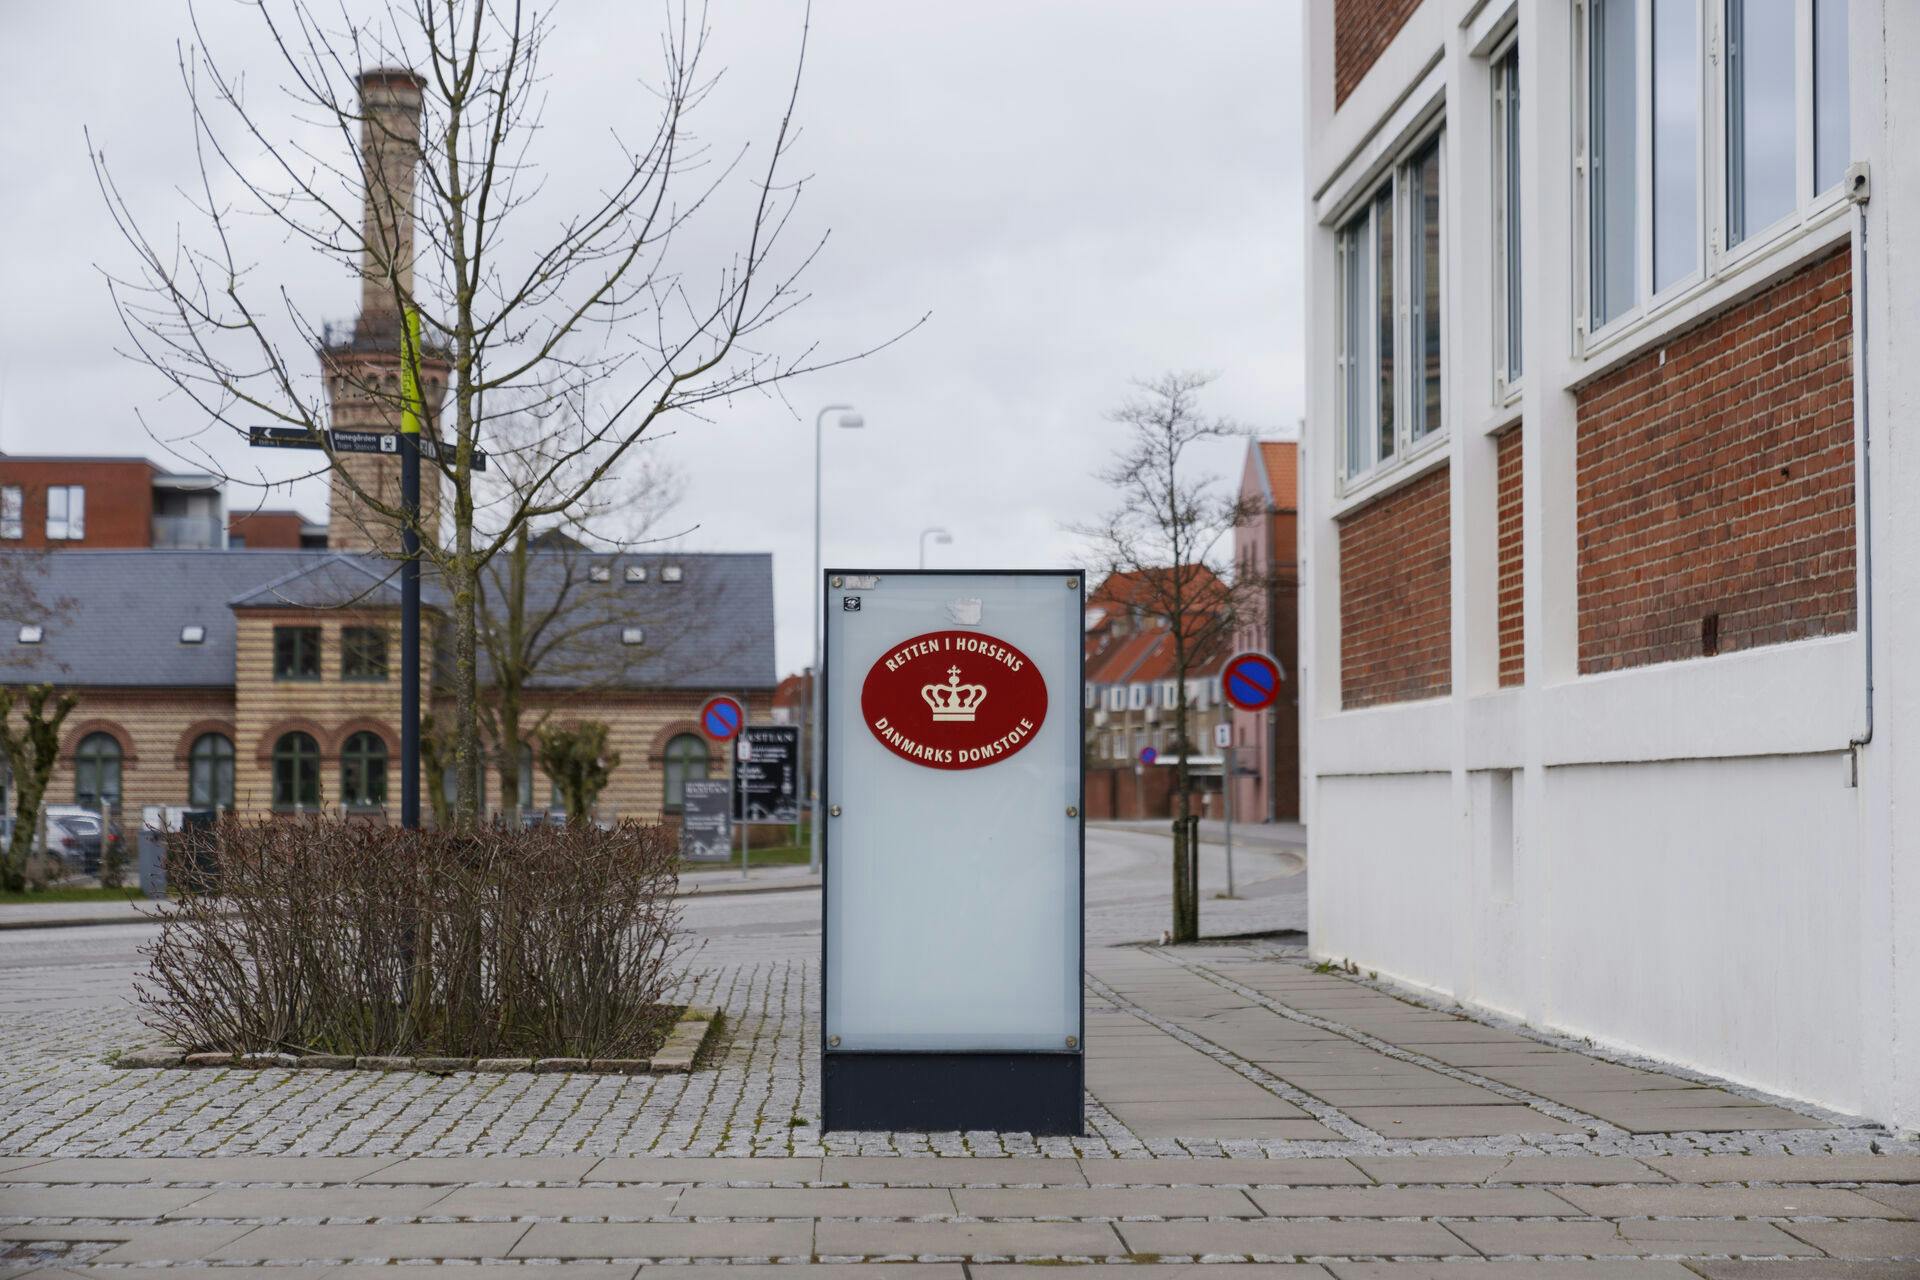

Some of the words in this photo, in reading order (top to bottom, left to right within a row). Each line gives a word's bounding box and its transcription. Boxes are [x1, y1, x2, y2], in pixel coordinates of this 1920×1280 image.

[885, 639, 940, 672] RETTEN
[945, 638, 951, 651] I
[956, 638, 1024, 672] HORSENS
[874, 717, 953, 763] DANMARKS
[958, 717, 1034, 763] DOMSTOLE
